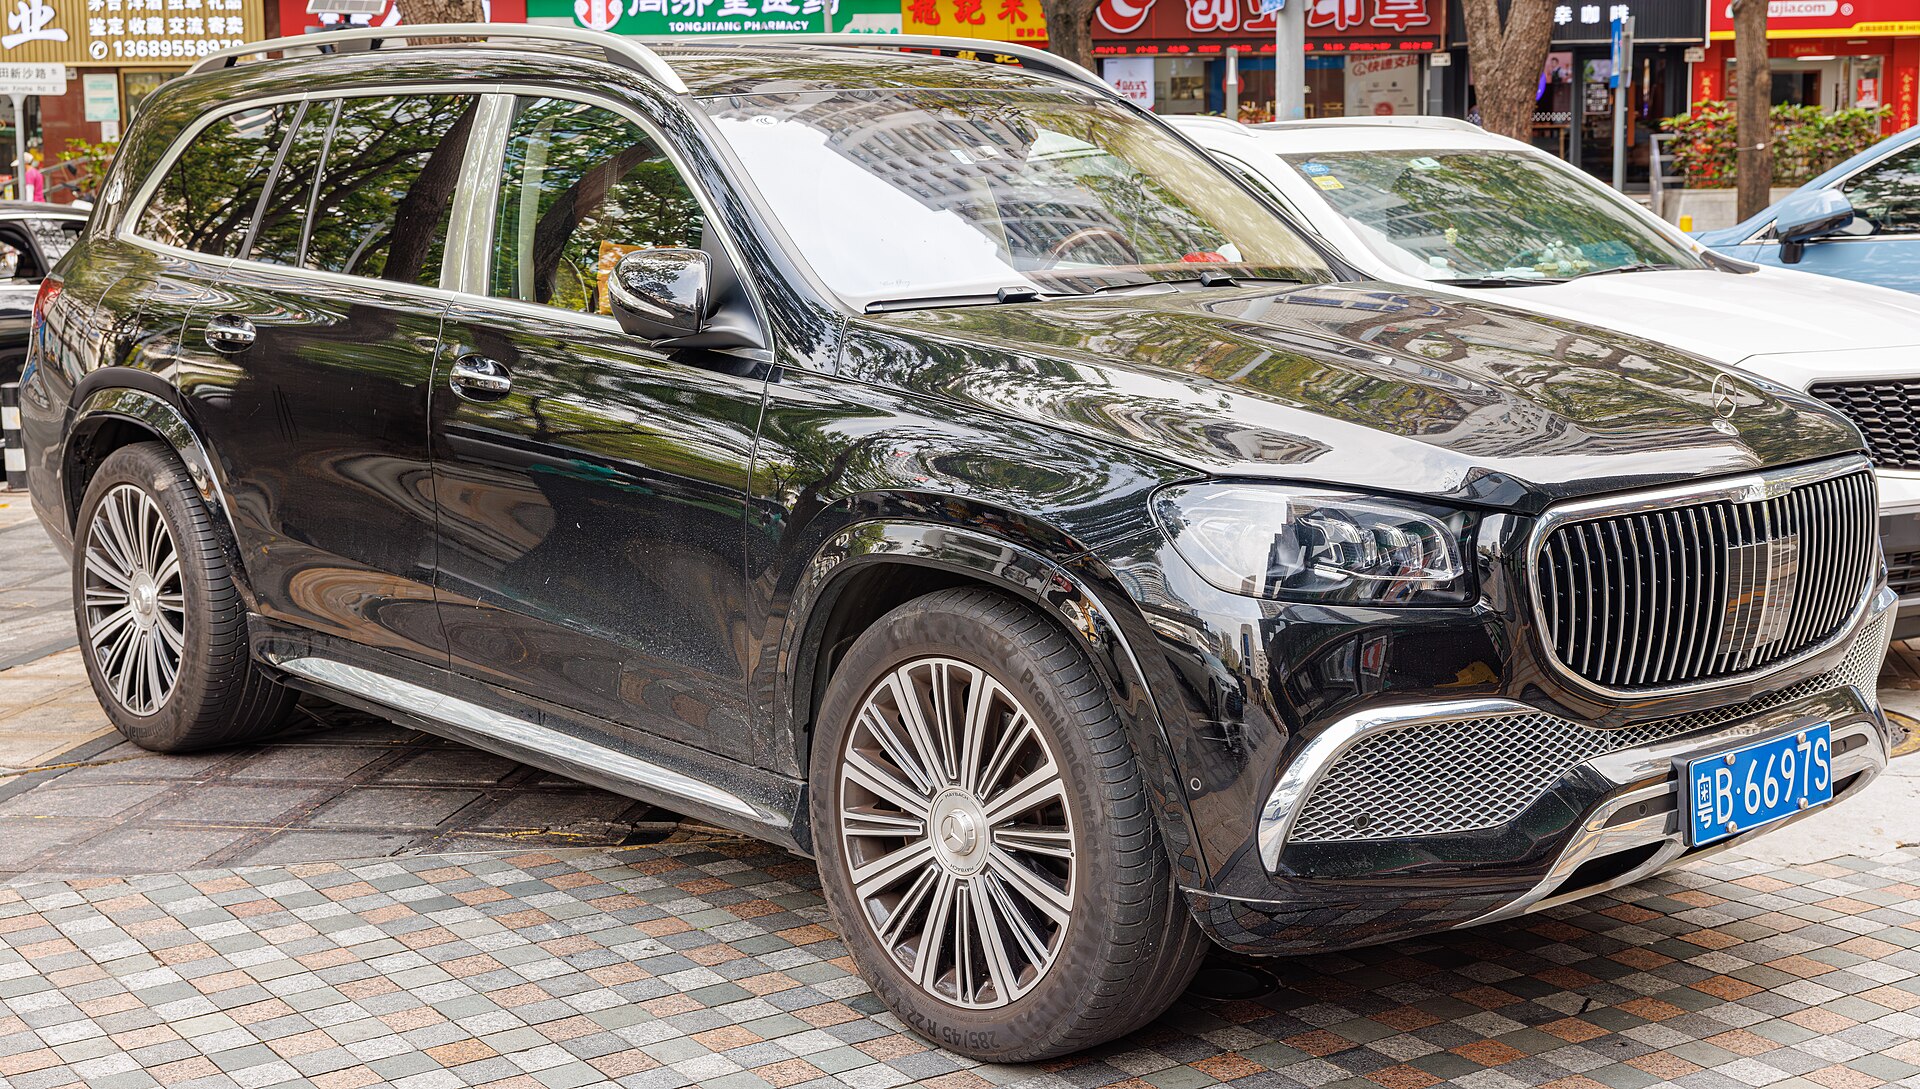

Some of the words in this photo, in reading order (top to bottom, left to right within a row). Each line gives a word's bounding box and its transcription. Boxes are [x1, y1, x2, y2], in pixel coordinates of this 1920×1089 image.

[89, 17, 125, 36] 鉴定
[128, 17, 165, 35] 收藏
[168, 17, 205, 35] 交流
[208, 16, 244, 35] 寄卖
[669, 21, 741, 32] TONGJITANG
[744, 20, 810, 31] PHARMACY
[945, 792, 969, 801] MAYBACH
[942, 1026, 1001, 1050] 285/45
